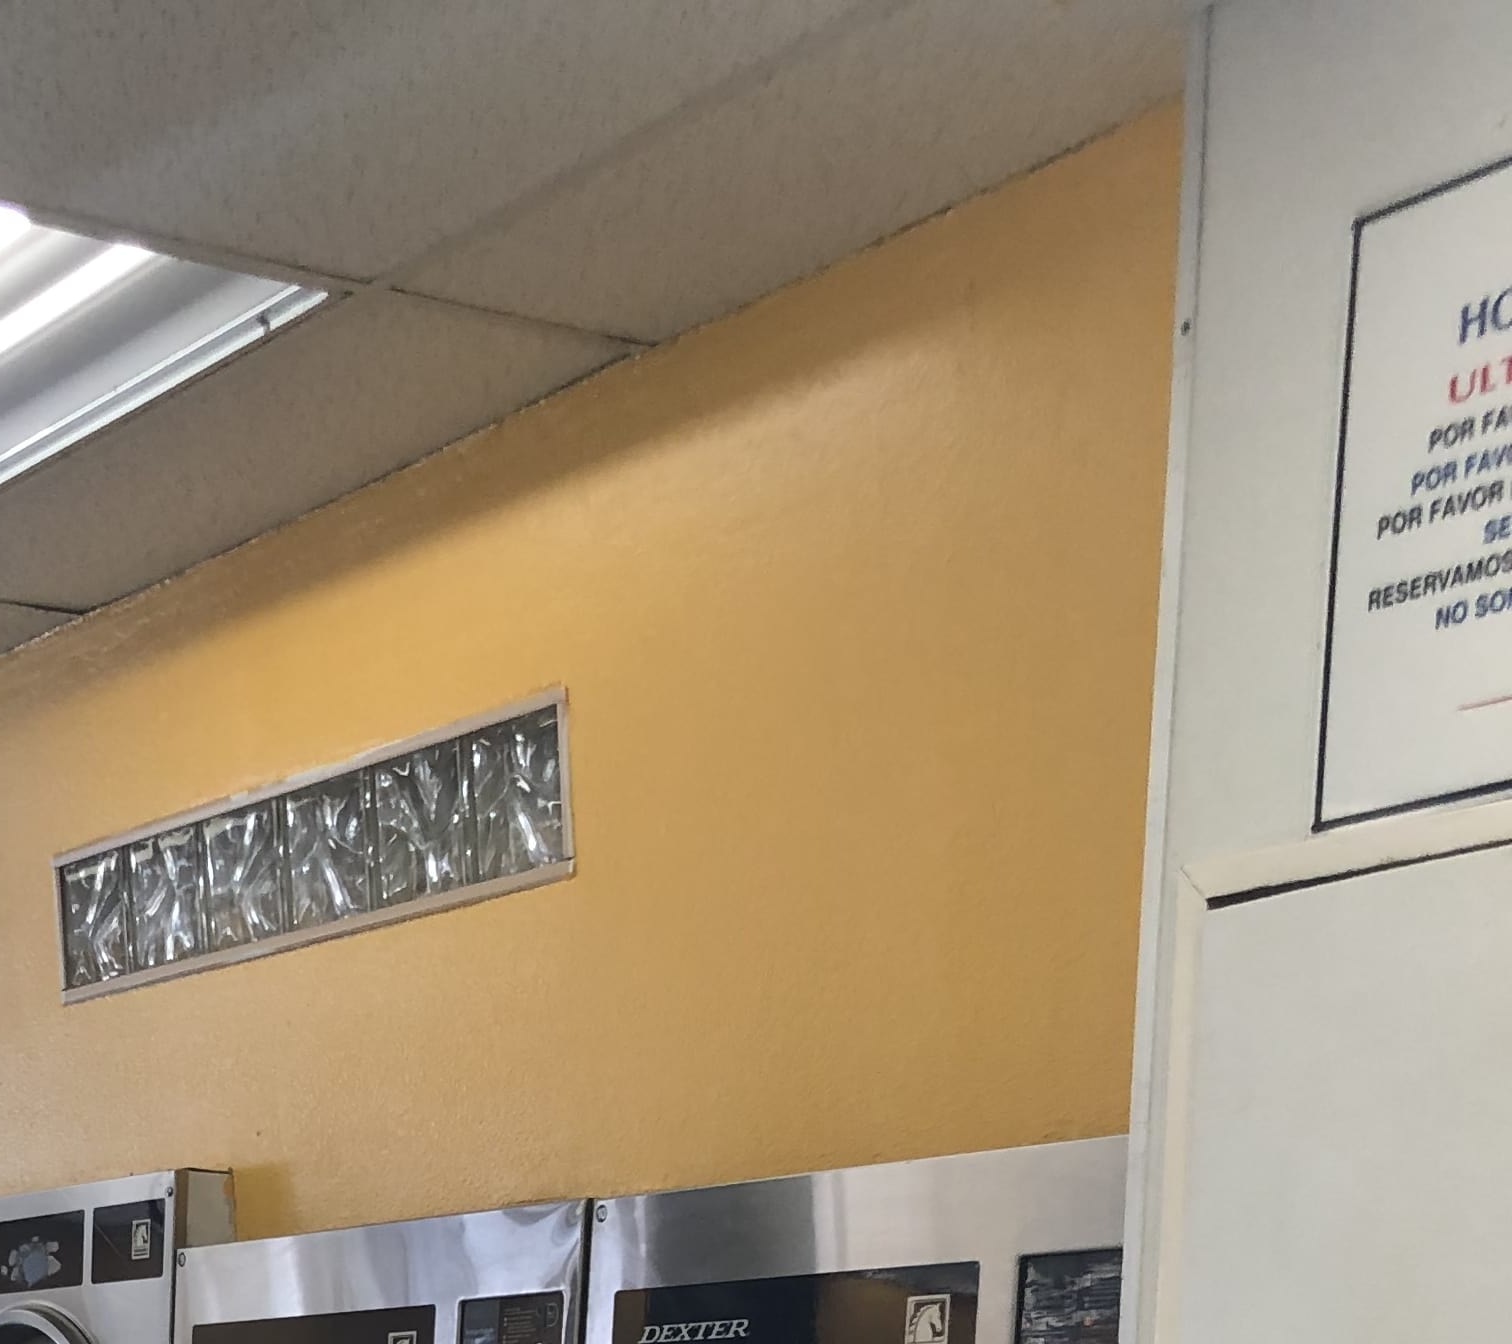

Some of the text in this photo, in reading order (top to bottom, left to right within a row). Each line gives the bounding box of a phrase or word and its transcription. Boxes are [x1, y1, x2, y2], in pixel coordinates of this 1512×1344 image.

[1428, 416, 1475, 453] POR
[1411, 460, 1457, 496] POR
[1377, 480, 1504, 540] POR FAVOR
[1368, 549, 1512, 612] RESERVAMOS
[1435, 601, 1468, 630] NO
[638, 1318, 750, 1344] DEXTER
